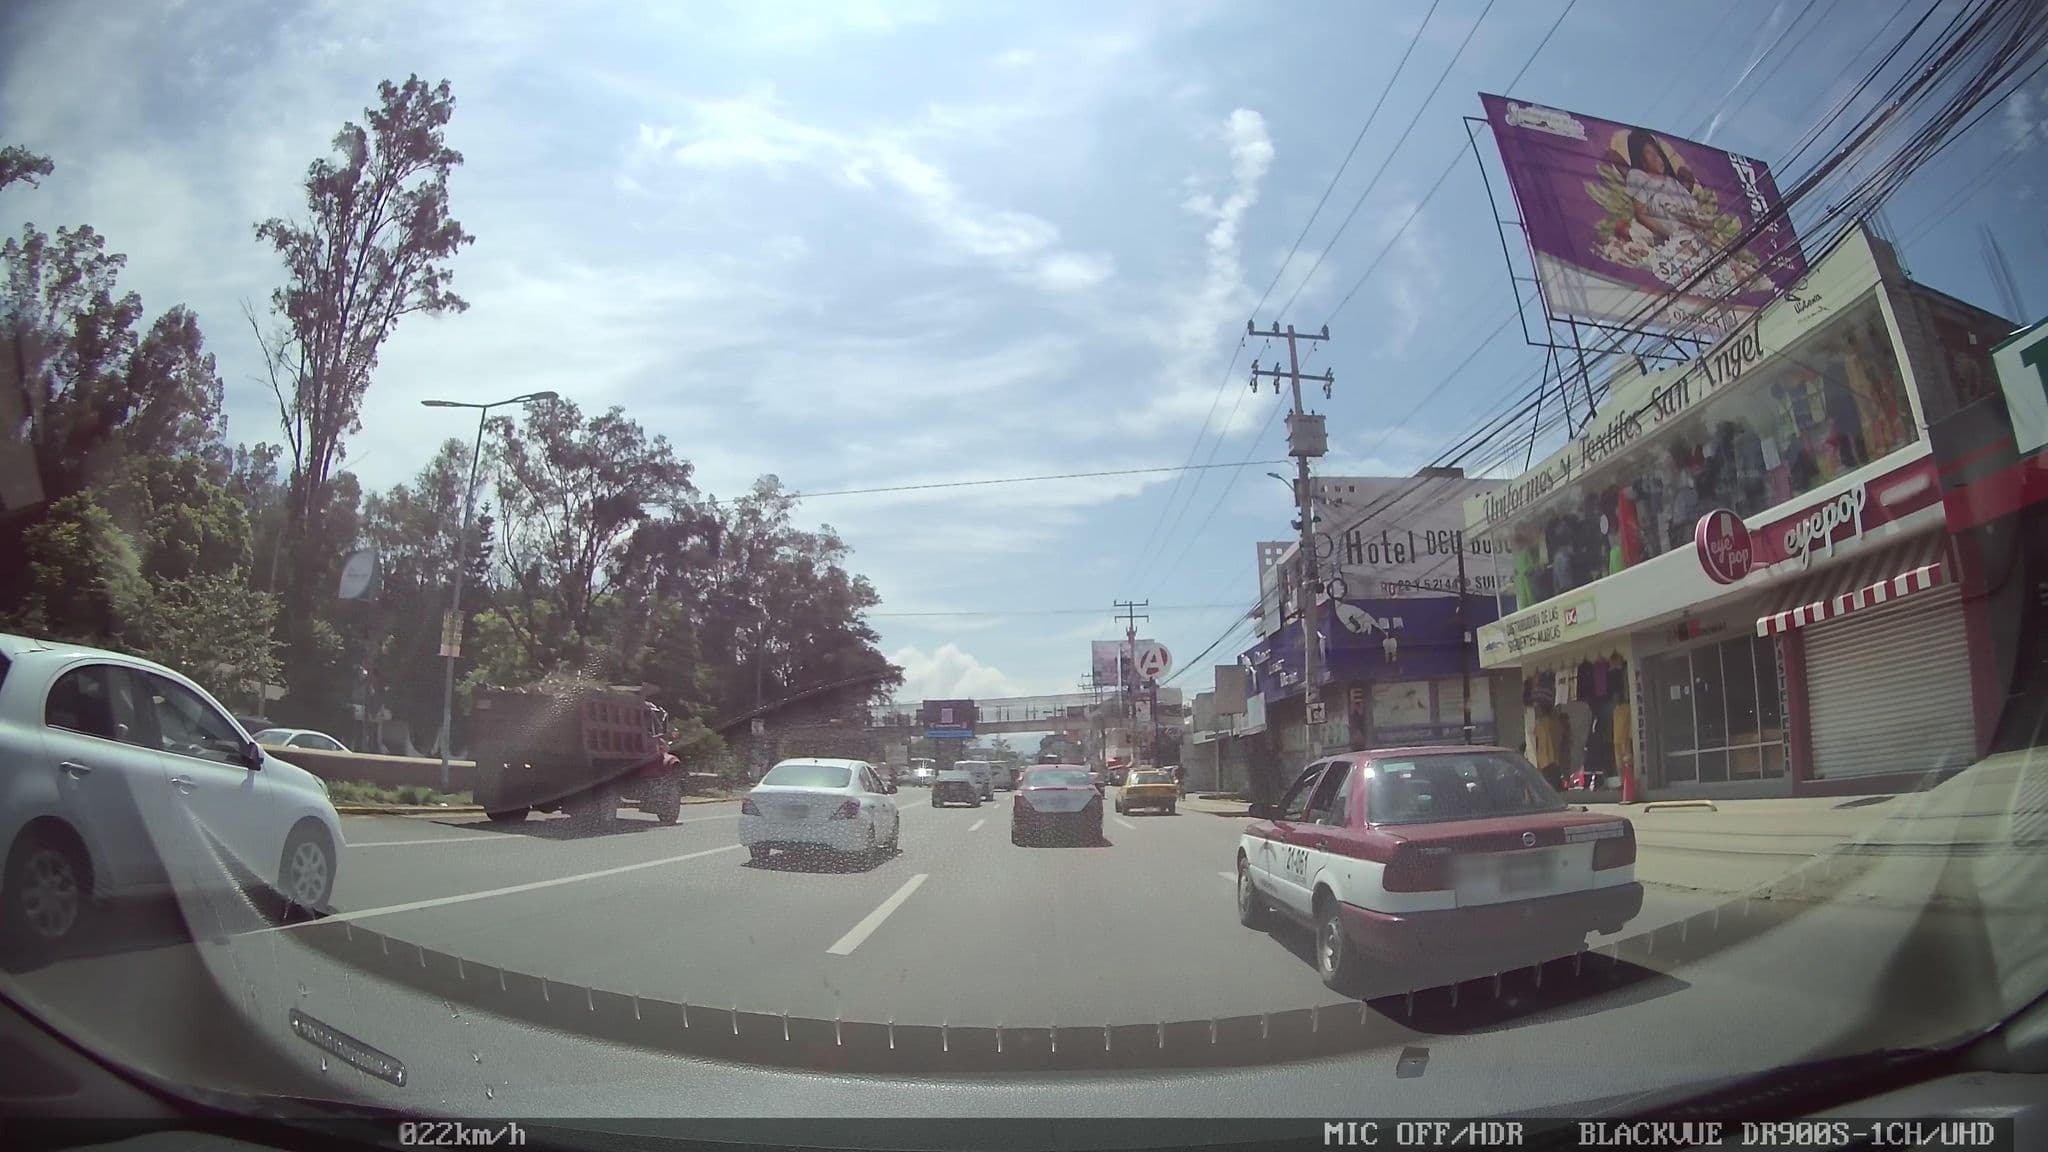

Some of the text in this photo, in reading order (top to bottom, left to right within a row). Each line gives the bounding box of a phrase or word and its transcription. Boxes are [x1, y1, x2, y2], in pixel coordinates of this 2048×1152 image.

[1483, 466, 1554, 523] Uniformes
[1578, 409, 1642, 469] Textiles
[1652, 378, 1690, 422] San
[1784, 479, 1867, 570] eyepop
[1345, 530, 1416, 565] Hotel
[1710, 537, 1733, 563] eye
[1728, 548, 1749, 577] pop
